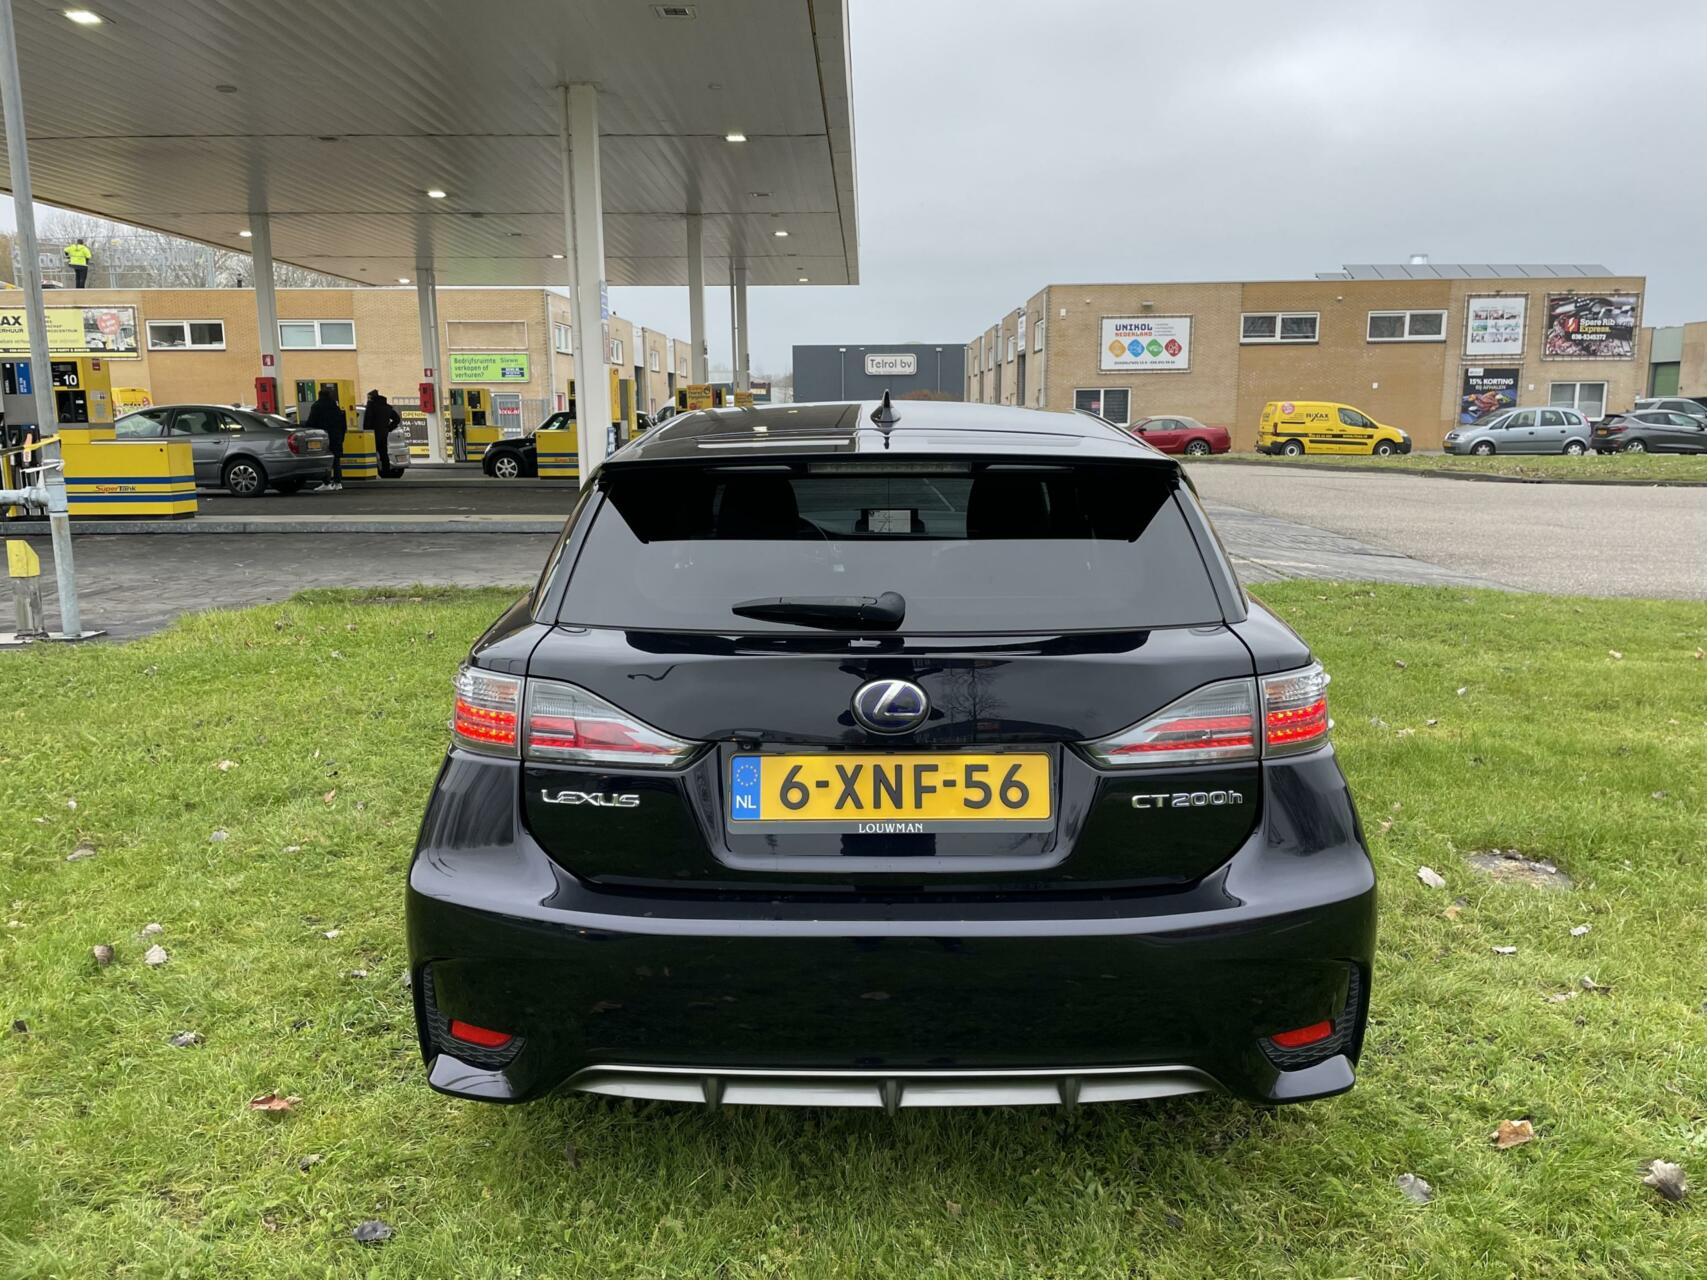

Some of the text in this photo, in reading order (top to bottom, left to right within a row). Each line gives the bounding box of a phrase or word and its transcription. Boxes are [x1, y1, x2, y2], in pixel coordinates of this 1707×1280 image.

[1115, 323, 1153, 331] UNIKOL
[1580, 318, 1602, 326] Spare
[870, 359, 912, 368] Telrol bv
[63, 374, 77, 385] 10
[735, 763, 1030, 810] NL 6-XNF-56
[541, 789, 640, 807] LEXUS
[858, 823, 924, 834] LOUWMAN
